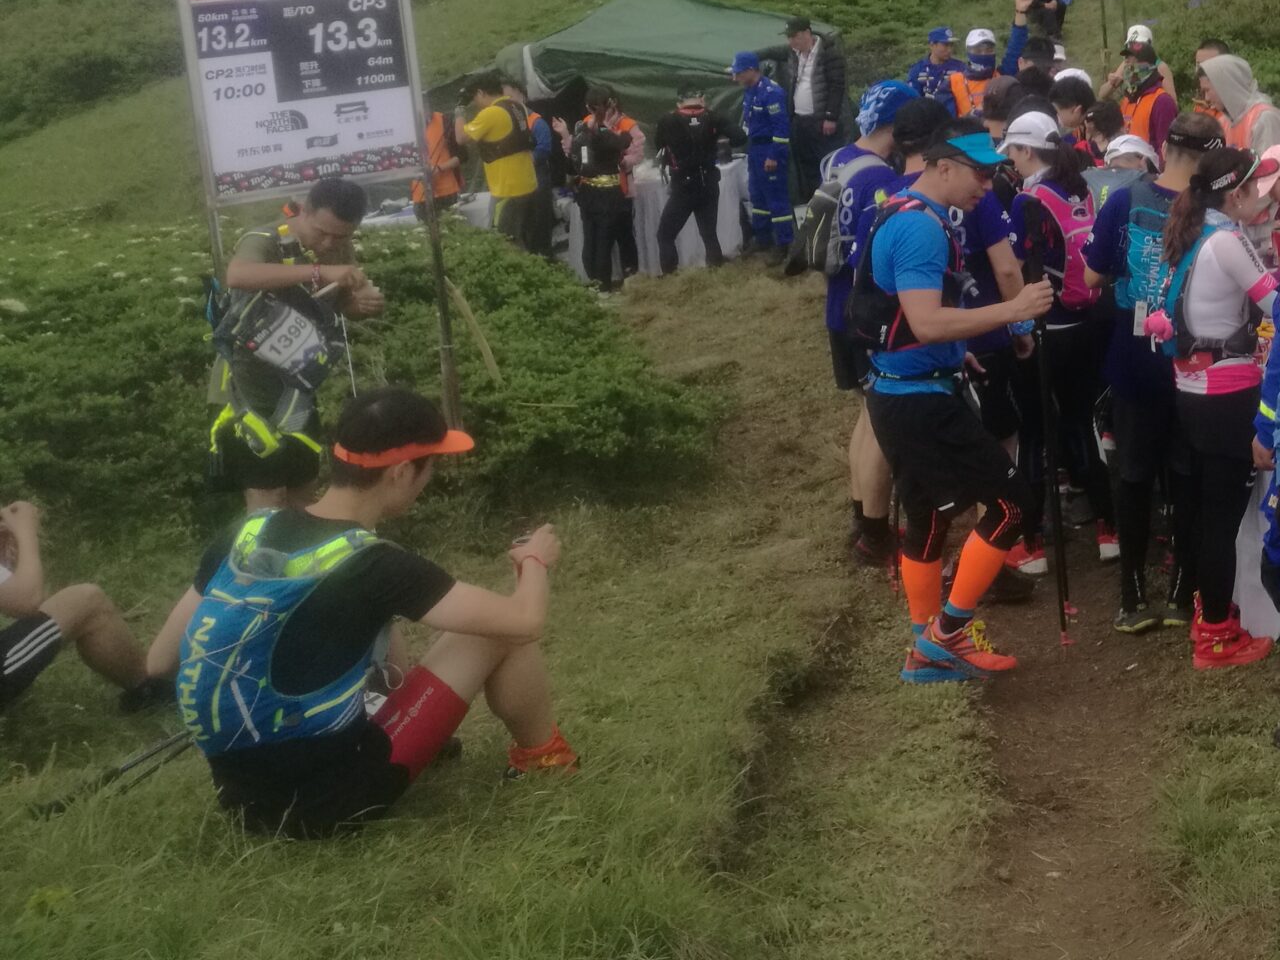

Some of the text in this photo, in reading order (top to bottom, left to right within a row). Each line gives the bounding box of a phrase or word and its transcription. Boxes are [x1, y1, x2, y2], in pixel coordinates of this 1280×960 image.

[198, 13, 228, 22] 50km
[367, 56, 393, 66] 64m
[205, 70, 233, 81] CP2
[356, 73, 396, 85] 1100m
[212, 83, 266, 101] 10:00
[270, 111, 290, 120] THE
[256, 117, 290, 129] NORTH
[266, 124, 291, 134] FACE
